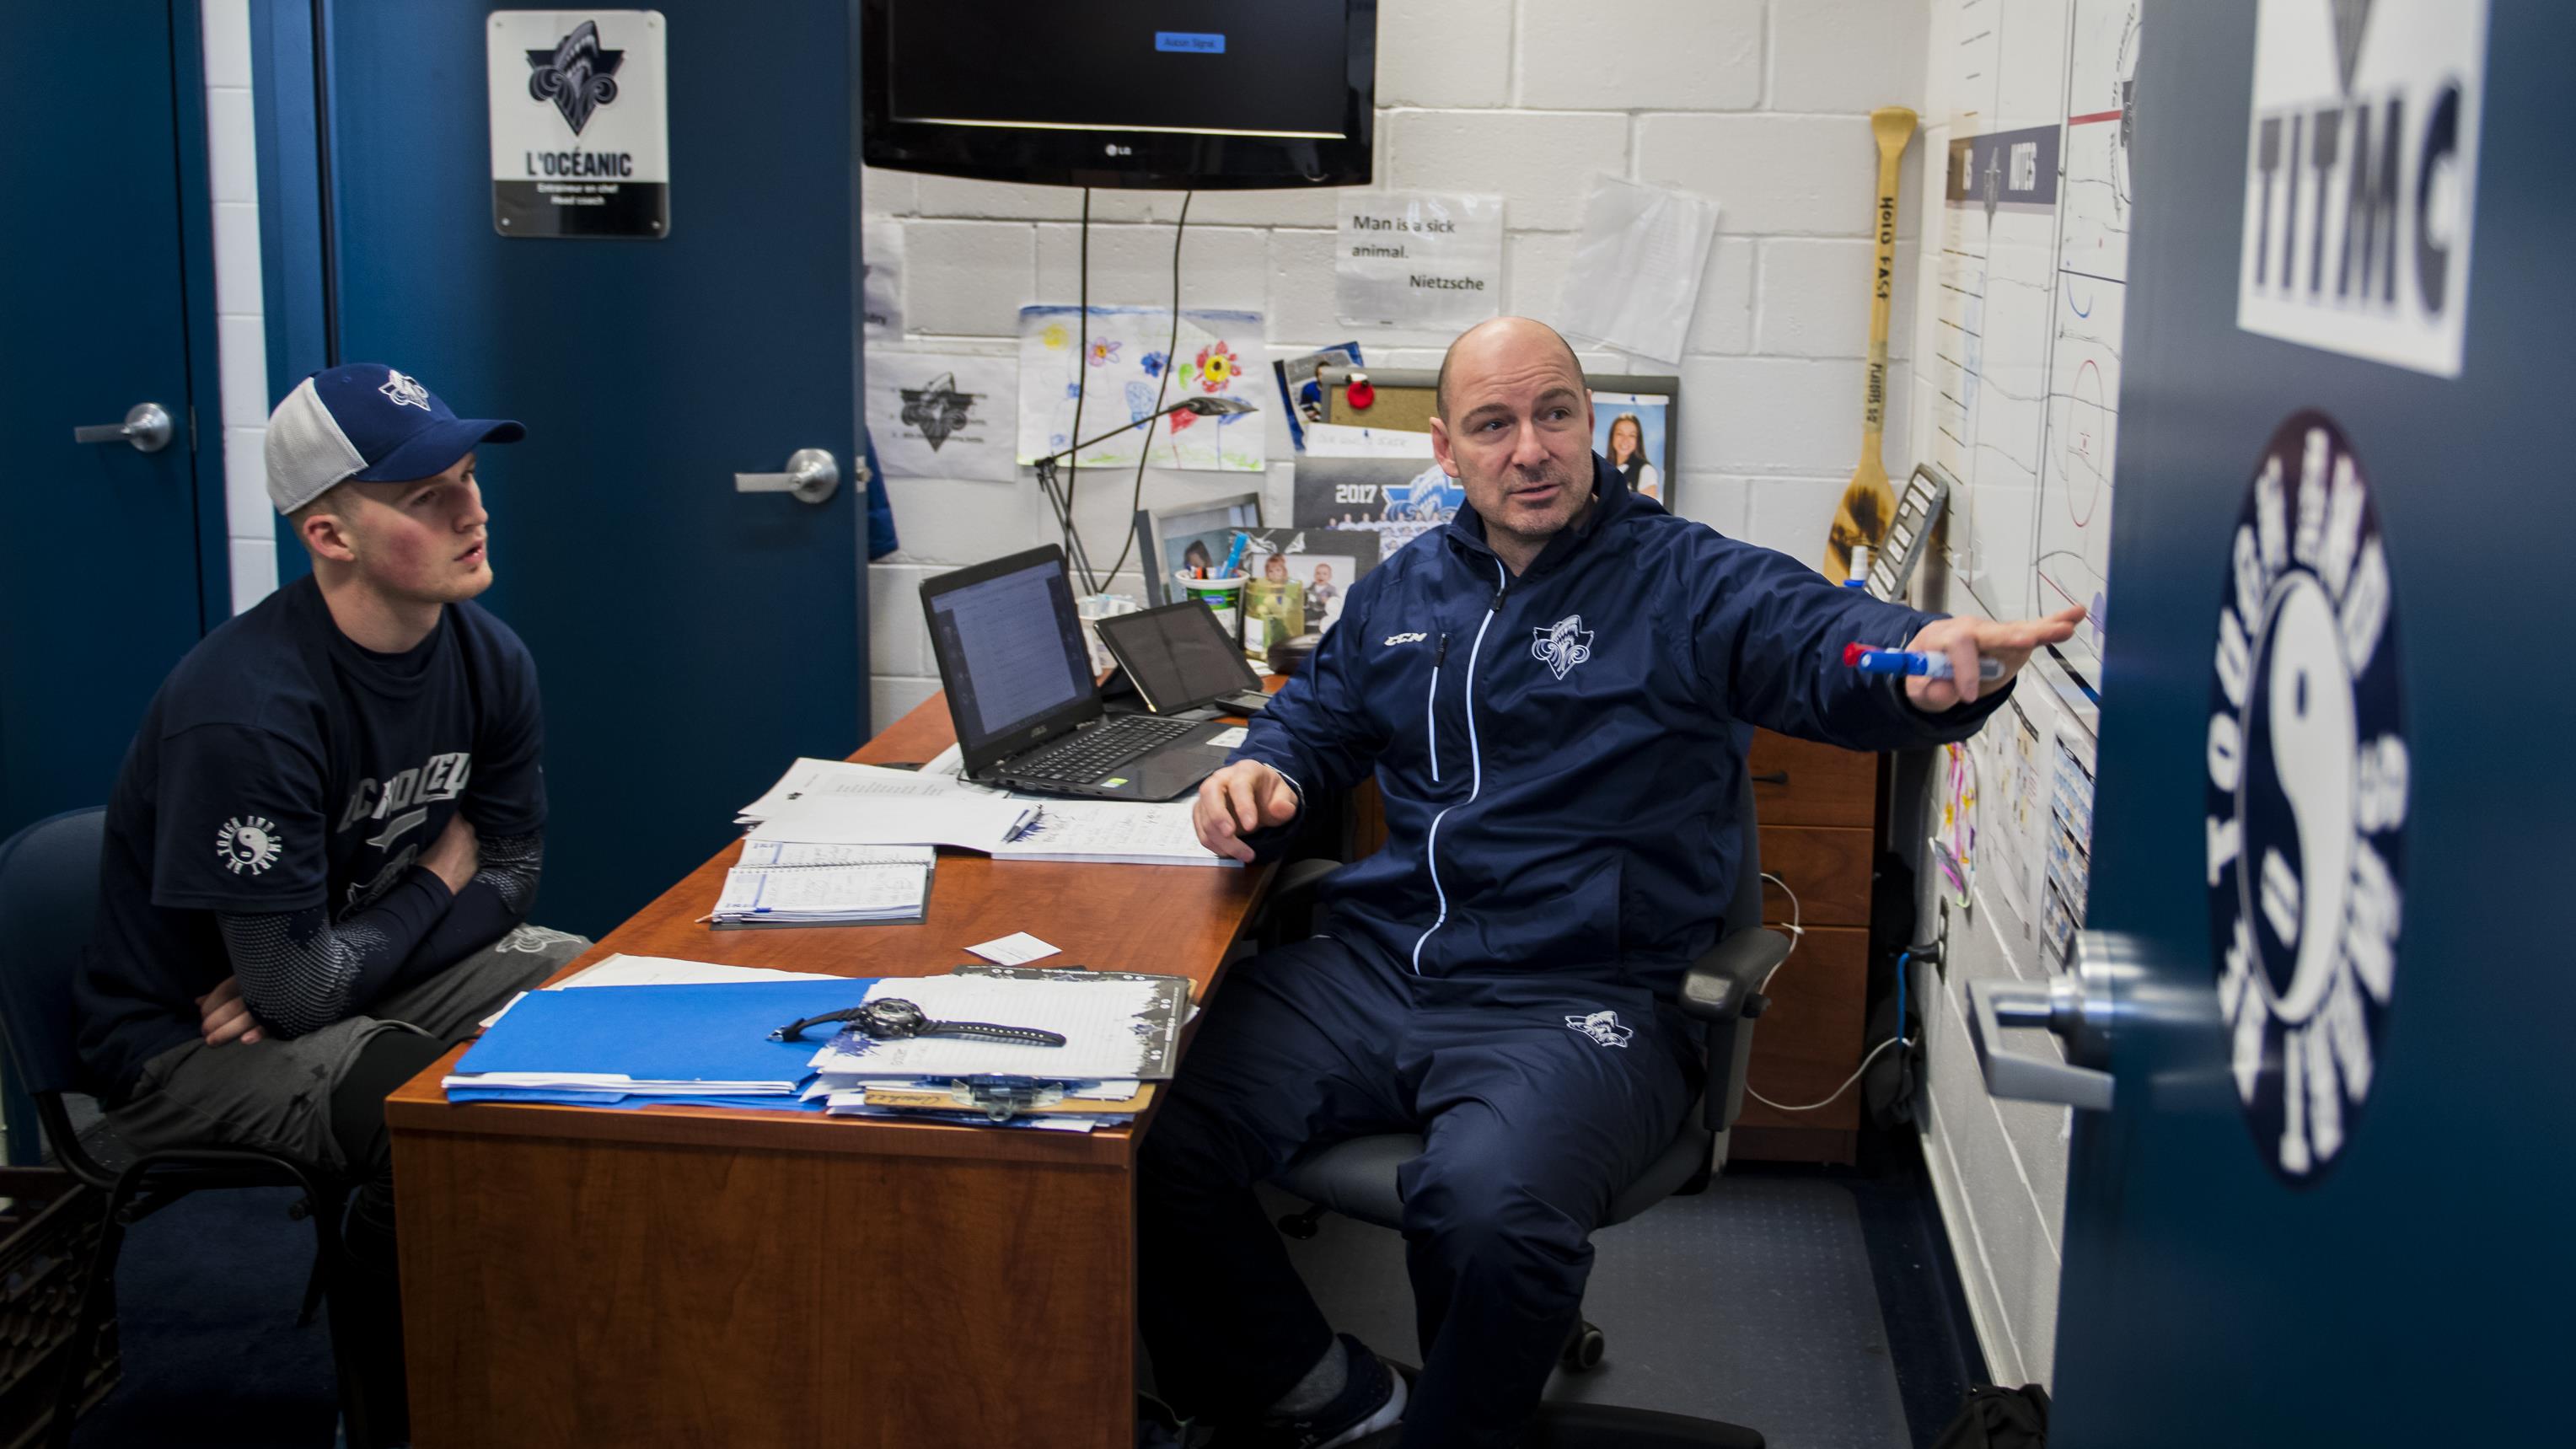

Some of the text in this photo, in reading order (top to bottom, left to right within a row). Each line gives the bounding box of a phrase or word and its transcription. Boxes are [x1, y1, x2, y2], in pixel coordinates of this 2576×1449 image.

[526, 146, 632, 177] L'OCÉANIC
[577, 195, 605, 206] coach
[1352, 215, 1456, 233] Man is a sick
[1351, 244, 1409, 259] animal.
[1409, 274, 1484, 291] Nietzsche
[1335, 484, 1377, 504] 2017
[1384, 632, 1428, 647] CCM
[245, 814, 276, 834] AND
[216, 816, 243, 857] TOUGH
[252, 835, 282, 876] SMART
